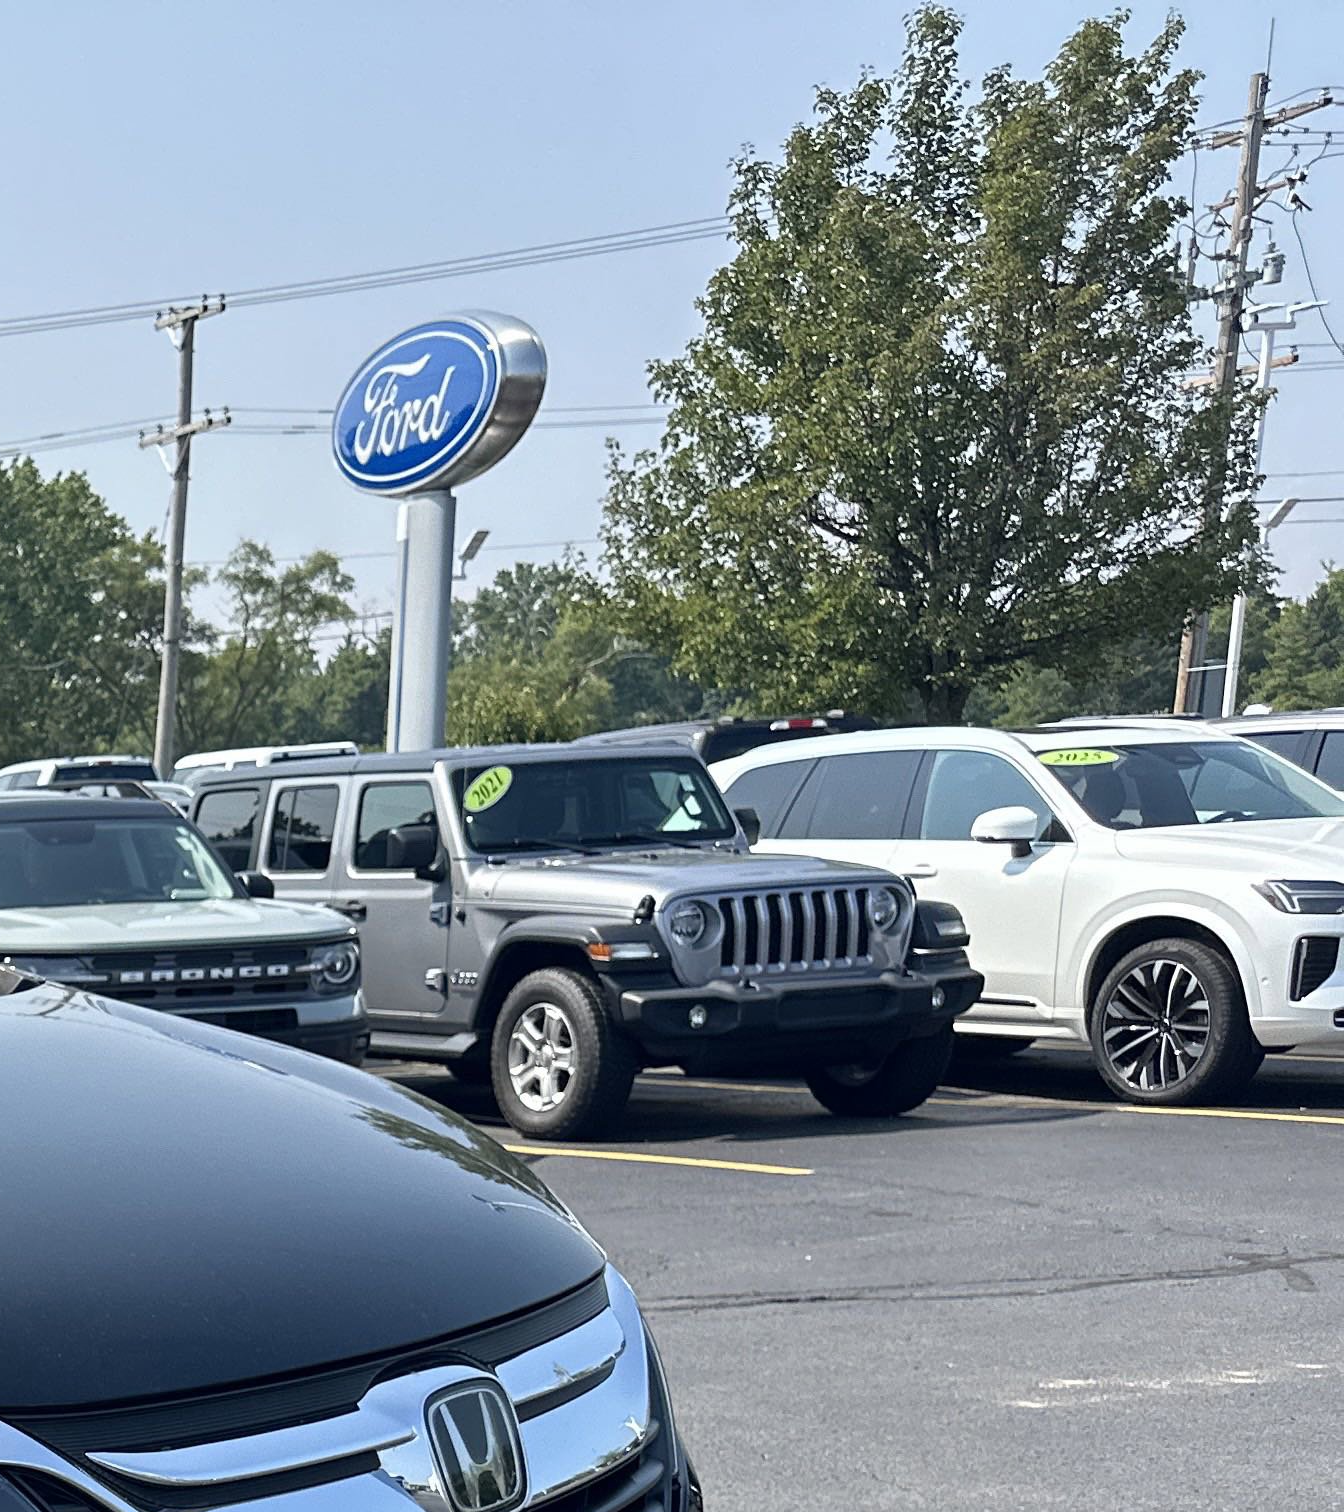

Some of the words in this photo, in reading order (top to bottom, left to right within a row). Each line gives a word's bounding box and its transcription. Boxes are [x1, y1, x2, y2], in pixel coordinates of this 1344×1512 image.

[354, 353, 456, 465] Ford
[472, 771, 503, 806] 2021
[120, 964, 289, 983] BRONCO
